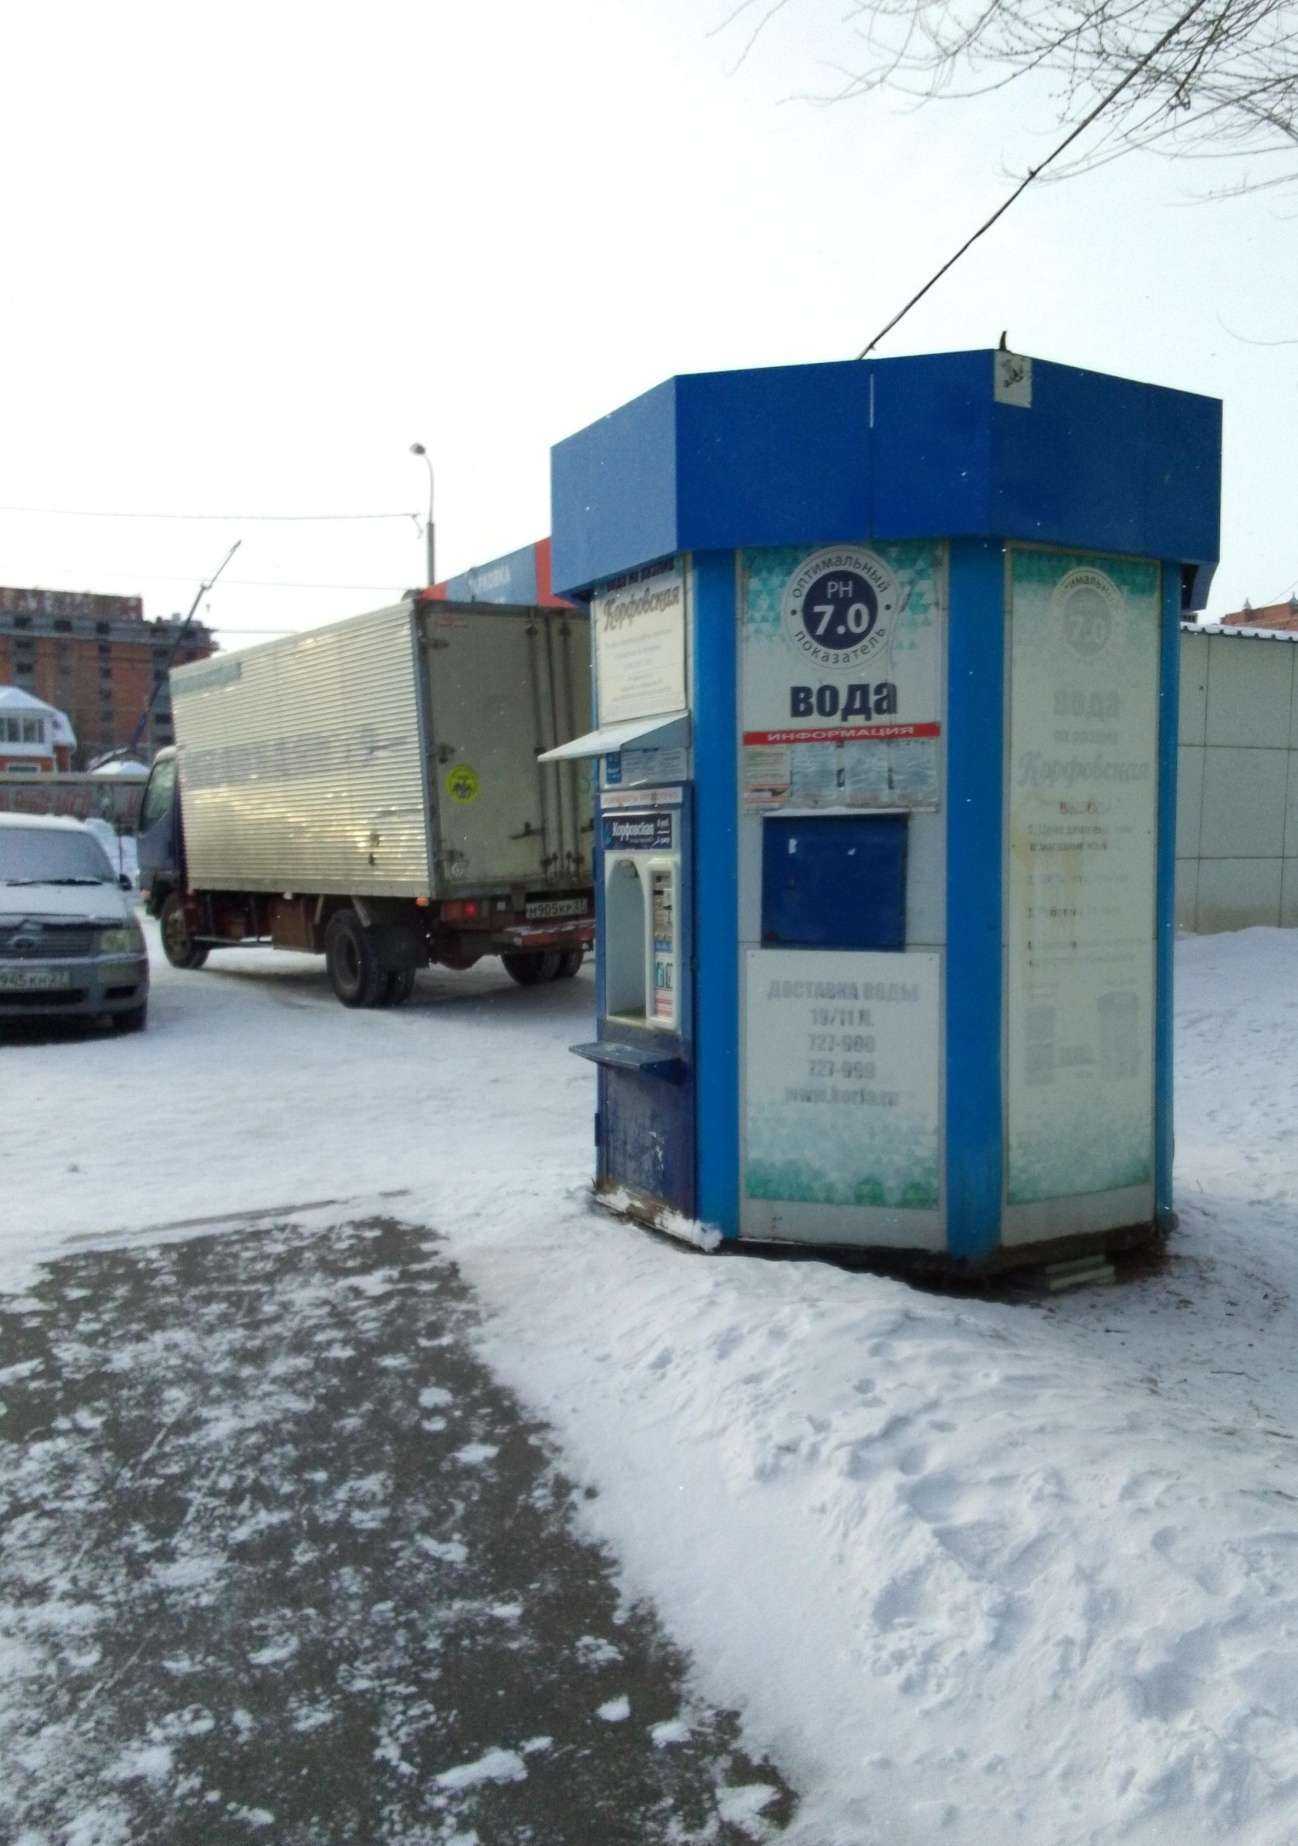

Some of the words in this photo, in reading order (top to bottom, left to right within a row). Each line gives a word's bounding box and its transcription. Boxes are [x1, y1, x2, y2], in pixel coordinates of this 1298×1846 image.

[792, 555, 890, 599] оптимальный
[813, 603, 870, 636] 7.0
[794, 627, 887, 665] показатель
[789, 682, 899, 722] вода
[766, 725, 915, 742] ИНФОРМАЦИЯ
